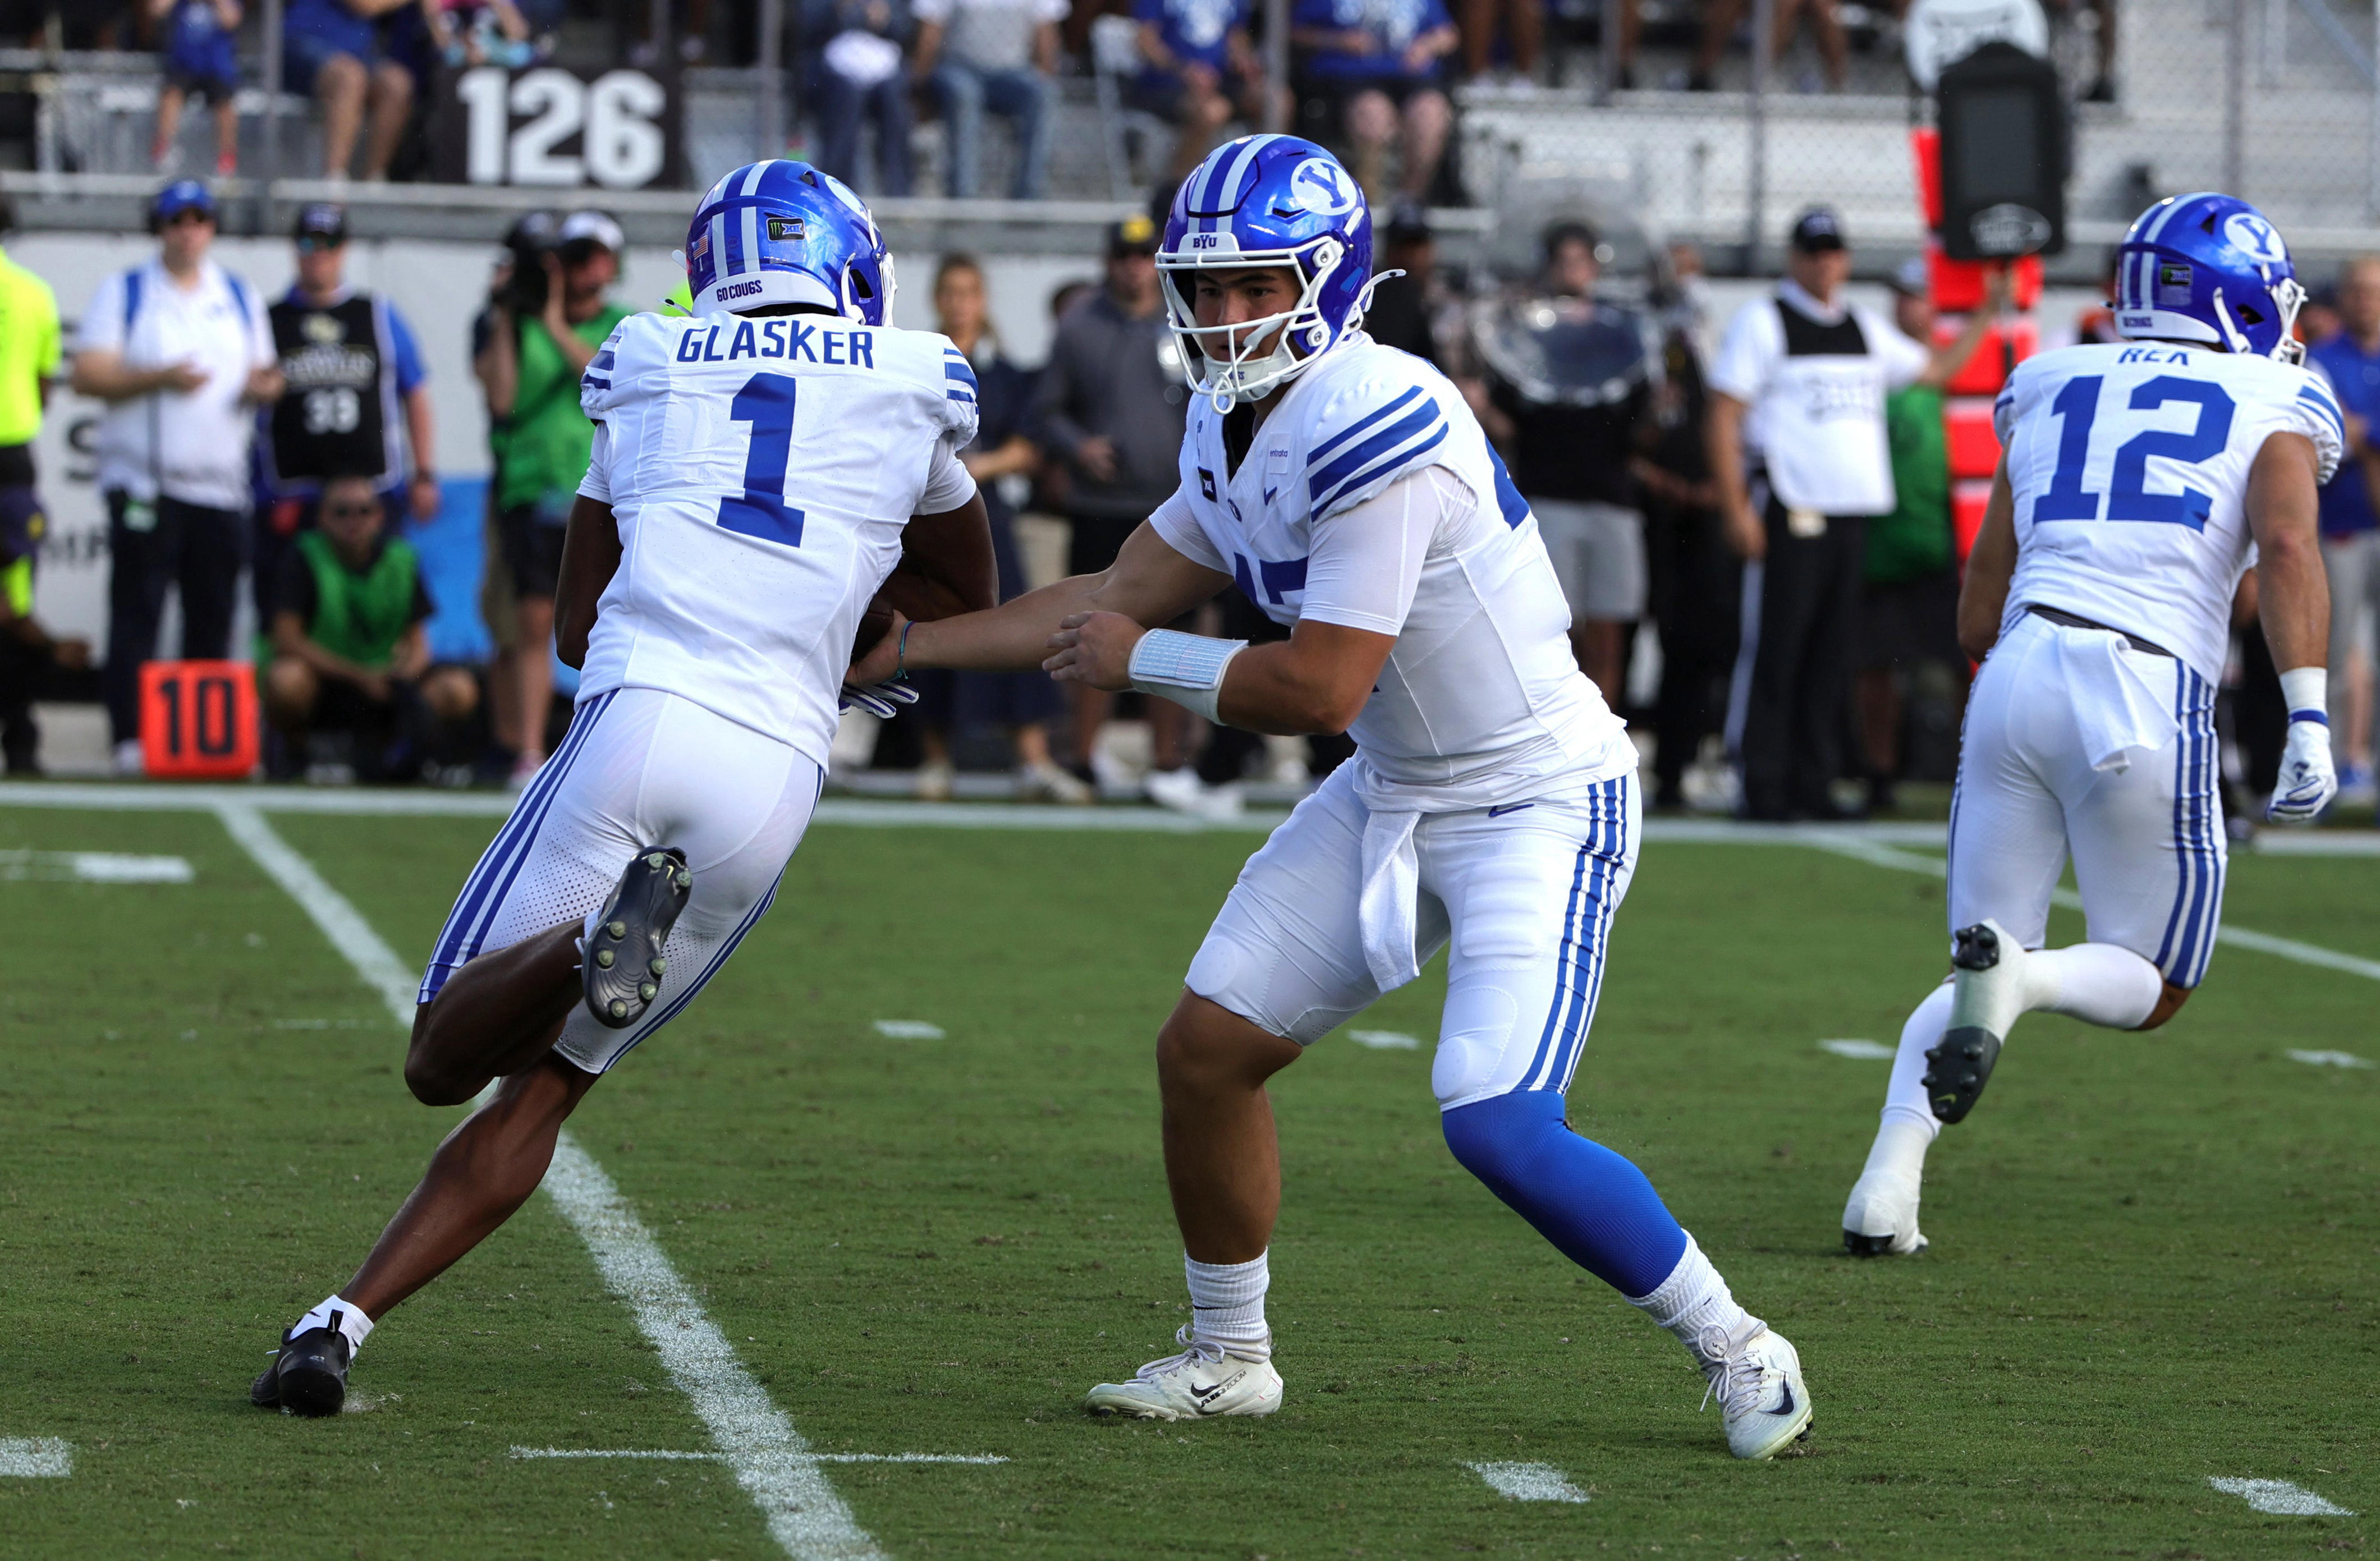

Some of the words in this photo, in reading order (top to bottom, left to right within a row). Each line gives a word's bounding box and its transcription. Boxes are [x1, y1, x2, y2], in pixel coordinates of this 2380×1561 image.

[456, 66, 666, 188] 126
[1297, 162, 1348, 208] Y
[1193, 235, 1217, 249] BYU
[2233, 218, 2272, 255] Y
[716, 287, 728, 302] GO
[730, 279, 763, 299] COUGS
[676, 319, 874, 370] GLASKER
[716, 372, 805, 548] 1
[2033, 374, 2236, 534] 12
[159, 679, 234, 756] 10
[1200, 1388, 1227, 1408] AIR
[1226, 1370, 1247, 1390] ZOOM
